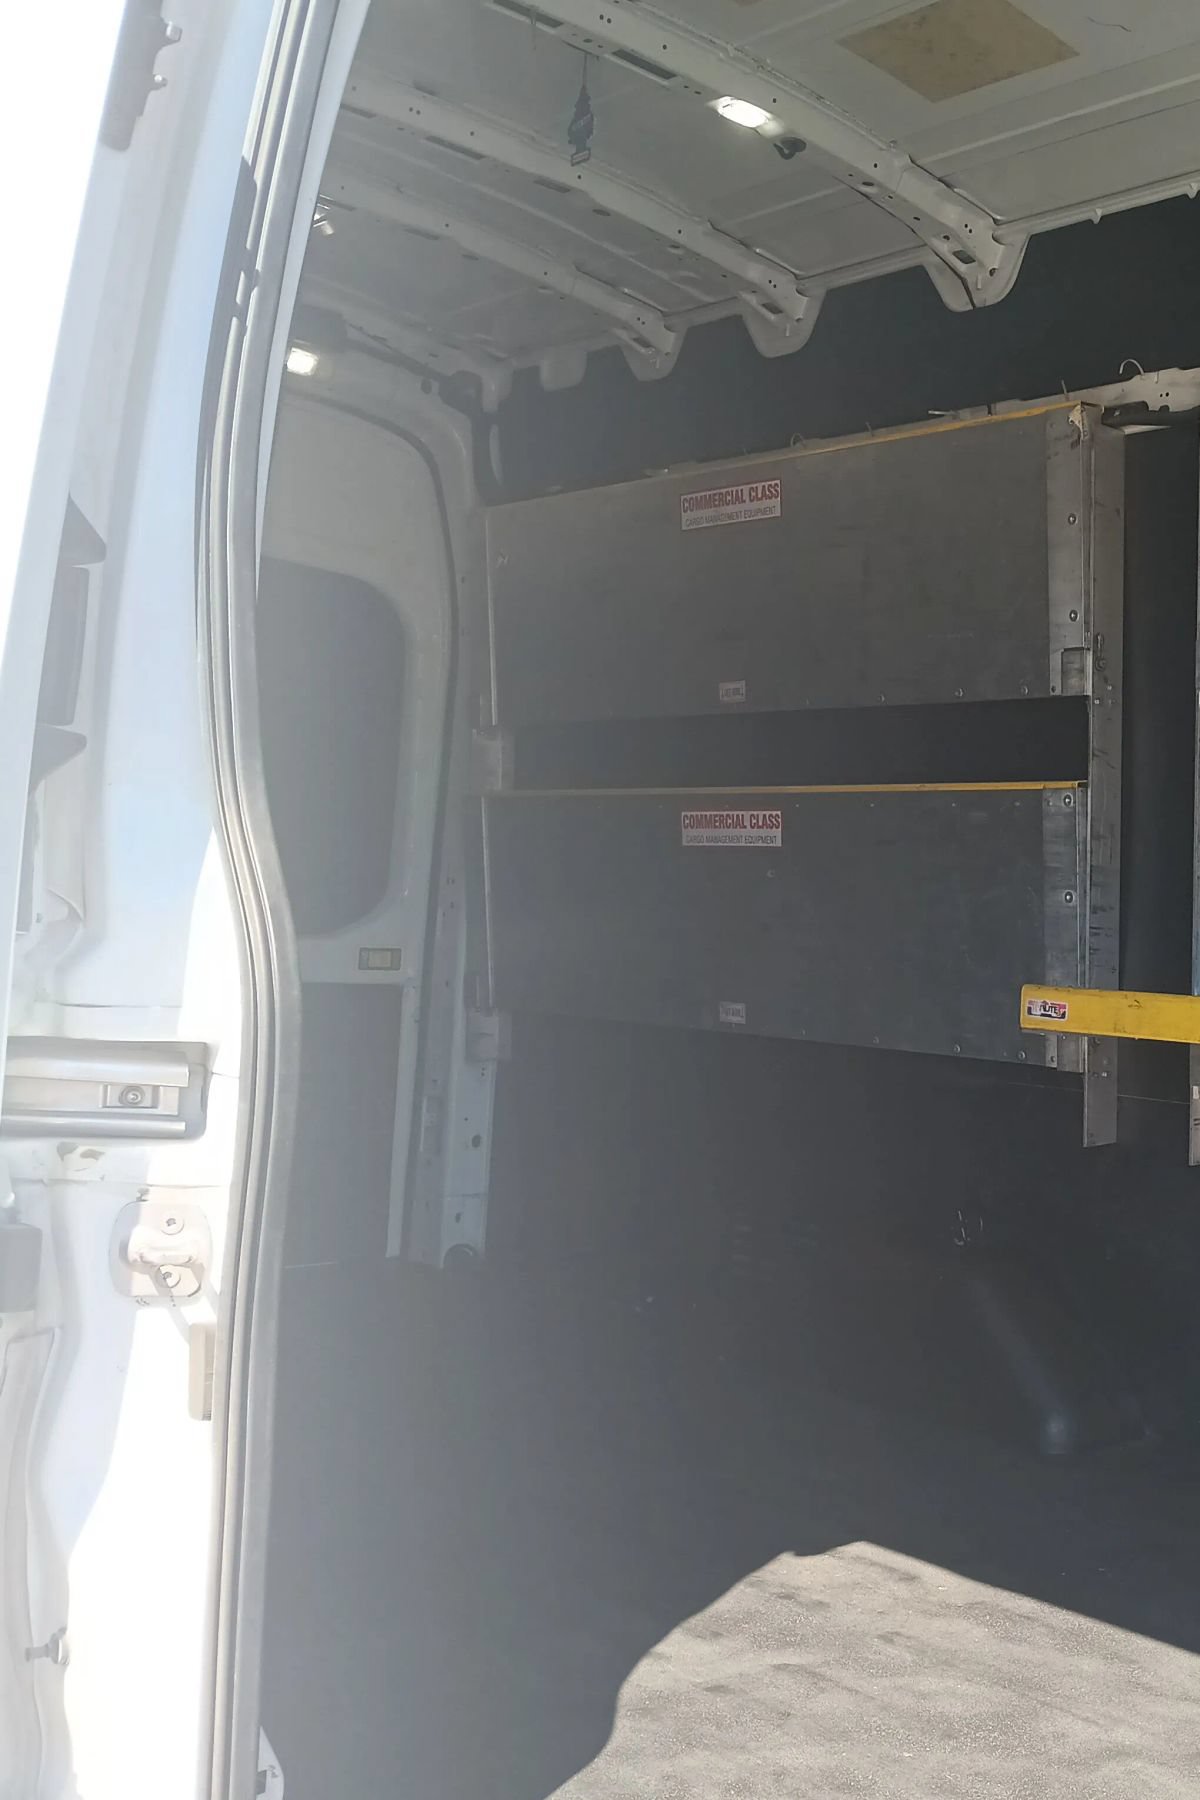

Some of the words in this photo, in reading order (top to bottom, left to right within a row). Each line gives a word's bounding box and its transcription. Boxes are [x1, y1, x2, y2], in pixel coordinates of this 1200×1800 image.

[682, 488, 747, 513] COMMERCIAL
[748, 482, 780, 503] CLASS
[682, 813, 748, 829] COMMERCIAL
[749, 813, 781, 829] CLASS
